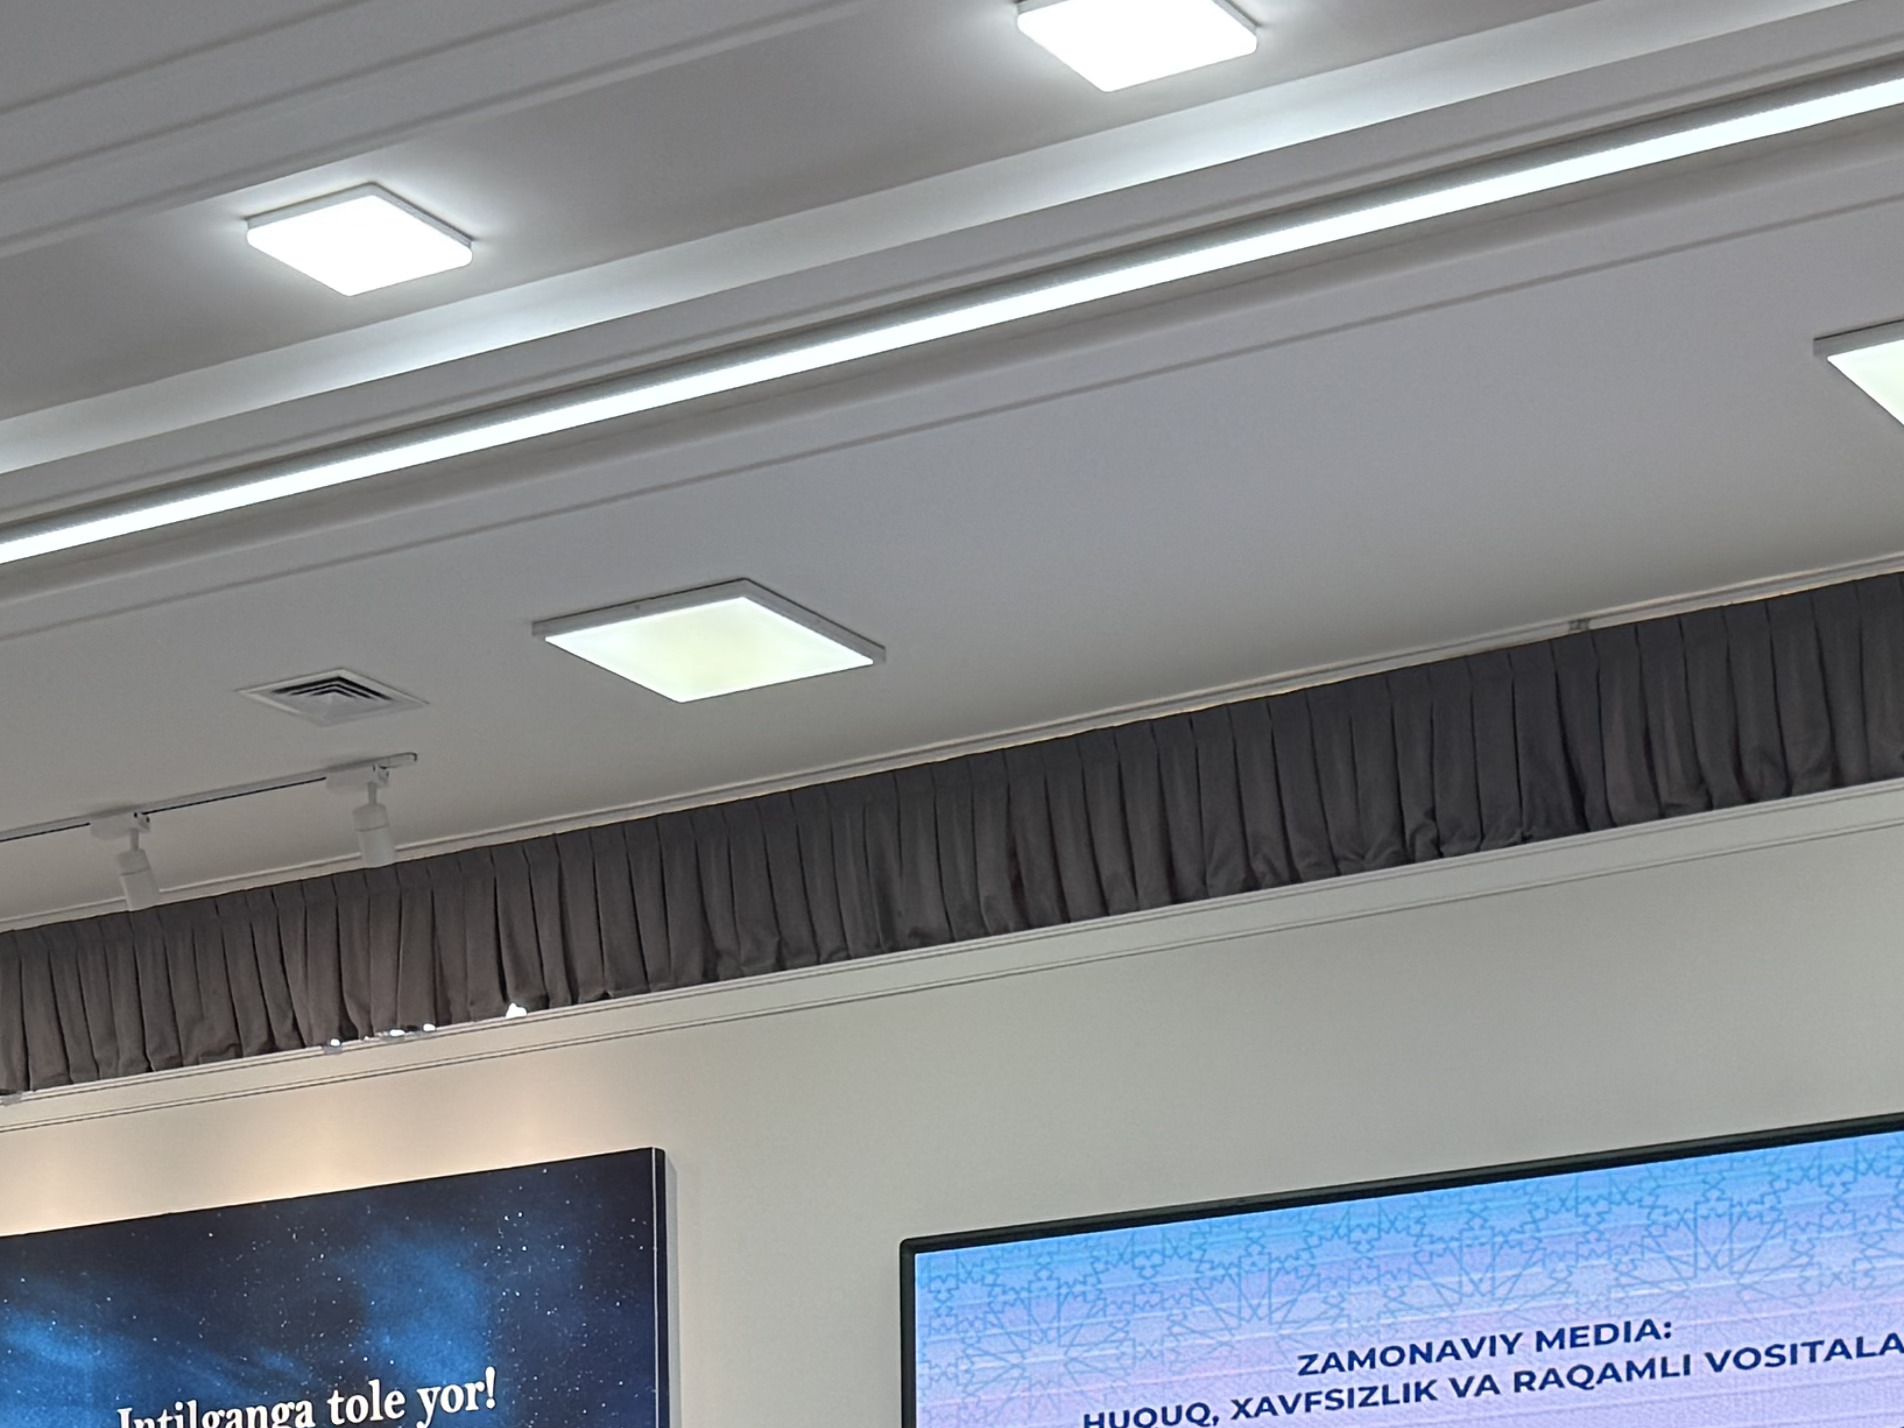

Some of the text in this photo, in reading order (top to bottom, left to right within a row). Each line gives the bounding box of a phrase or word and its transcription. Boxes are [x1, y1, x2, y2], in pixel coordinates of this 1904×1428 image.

[1296, 1319, 1673, 1377] ZAMONAVIY MEDIA:
[327, 1379, 406, 1427] tole
[1230, 1379, 1439, 1421] XAVFSIZLIK
[1448, 1373, 1502, 1399] VA
[1513, 1354, 1691, 1393] RAQAMLI
